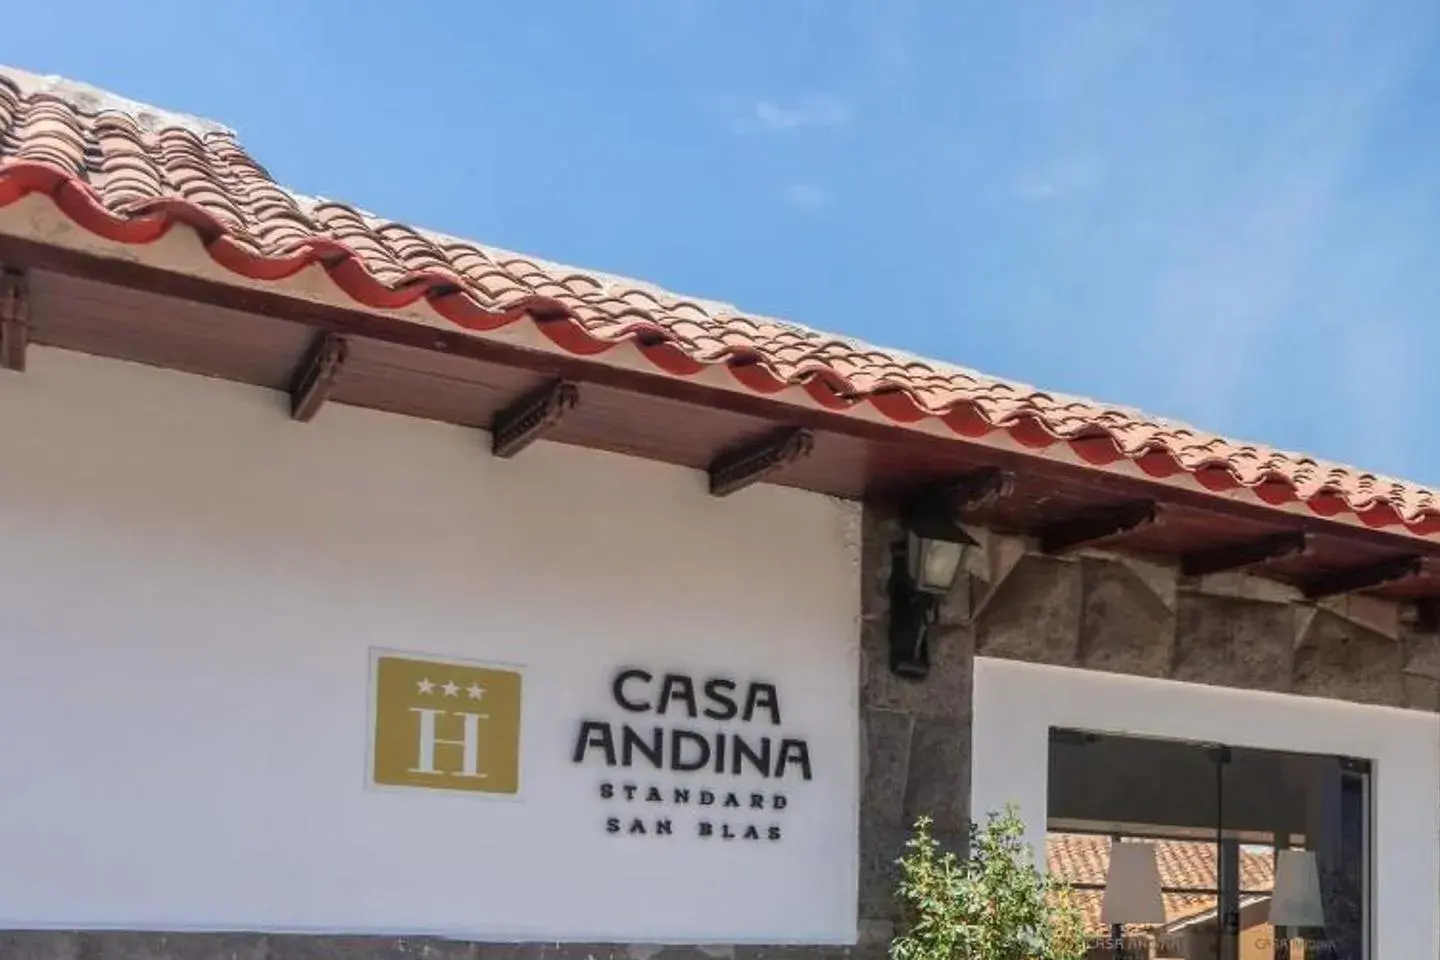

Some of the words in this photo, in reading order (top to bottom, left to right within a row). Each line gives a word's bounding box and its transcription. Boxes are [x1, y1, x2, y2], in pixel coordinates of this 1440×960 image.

[612, 669, 782, 726] CASA
[408, 707, 490, 778] H
[572, 720, 813, 781] ANDINA
[600, 782, 788, 810] STANDARD
[606, 817, 673, 835] SAN
[699, 821, 781, 840] BLAS
[1127, 938, 1181, 951] ANNA
